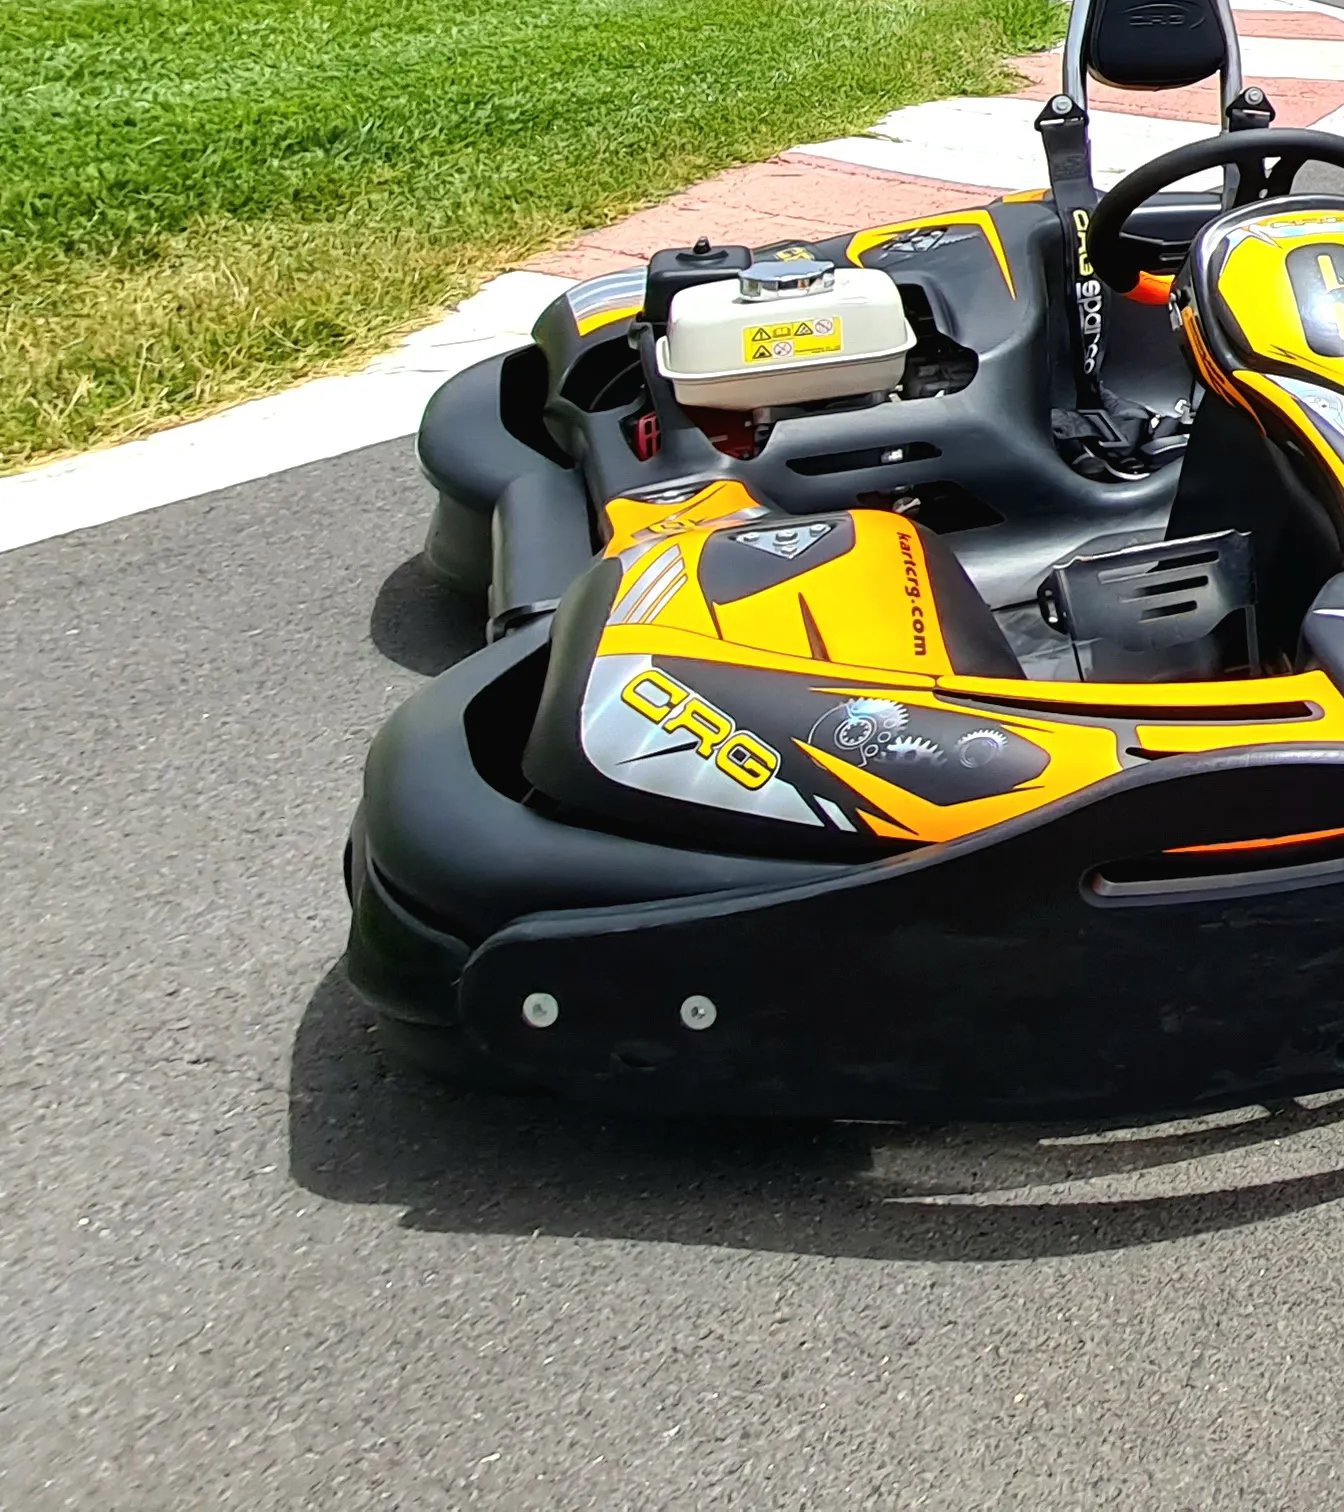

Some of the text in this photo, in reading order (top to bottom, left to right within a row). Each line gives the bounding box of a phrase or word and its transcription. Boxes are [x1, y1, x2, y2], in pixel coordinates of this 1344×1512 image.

[1076, 279, 1103, 375] sparco
[896, 531, 927, 657] kartcrg.com
[619, 668, 780, 791] CRG
